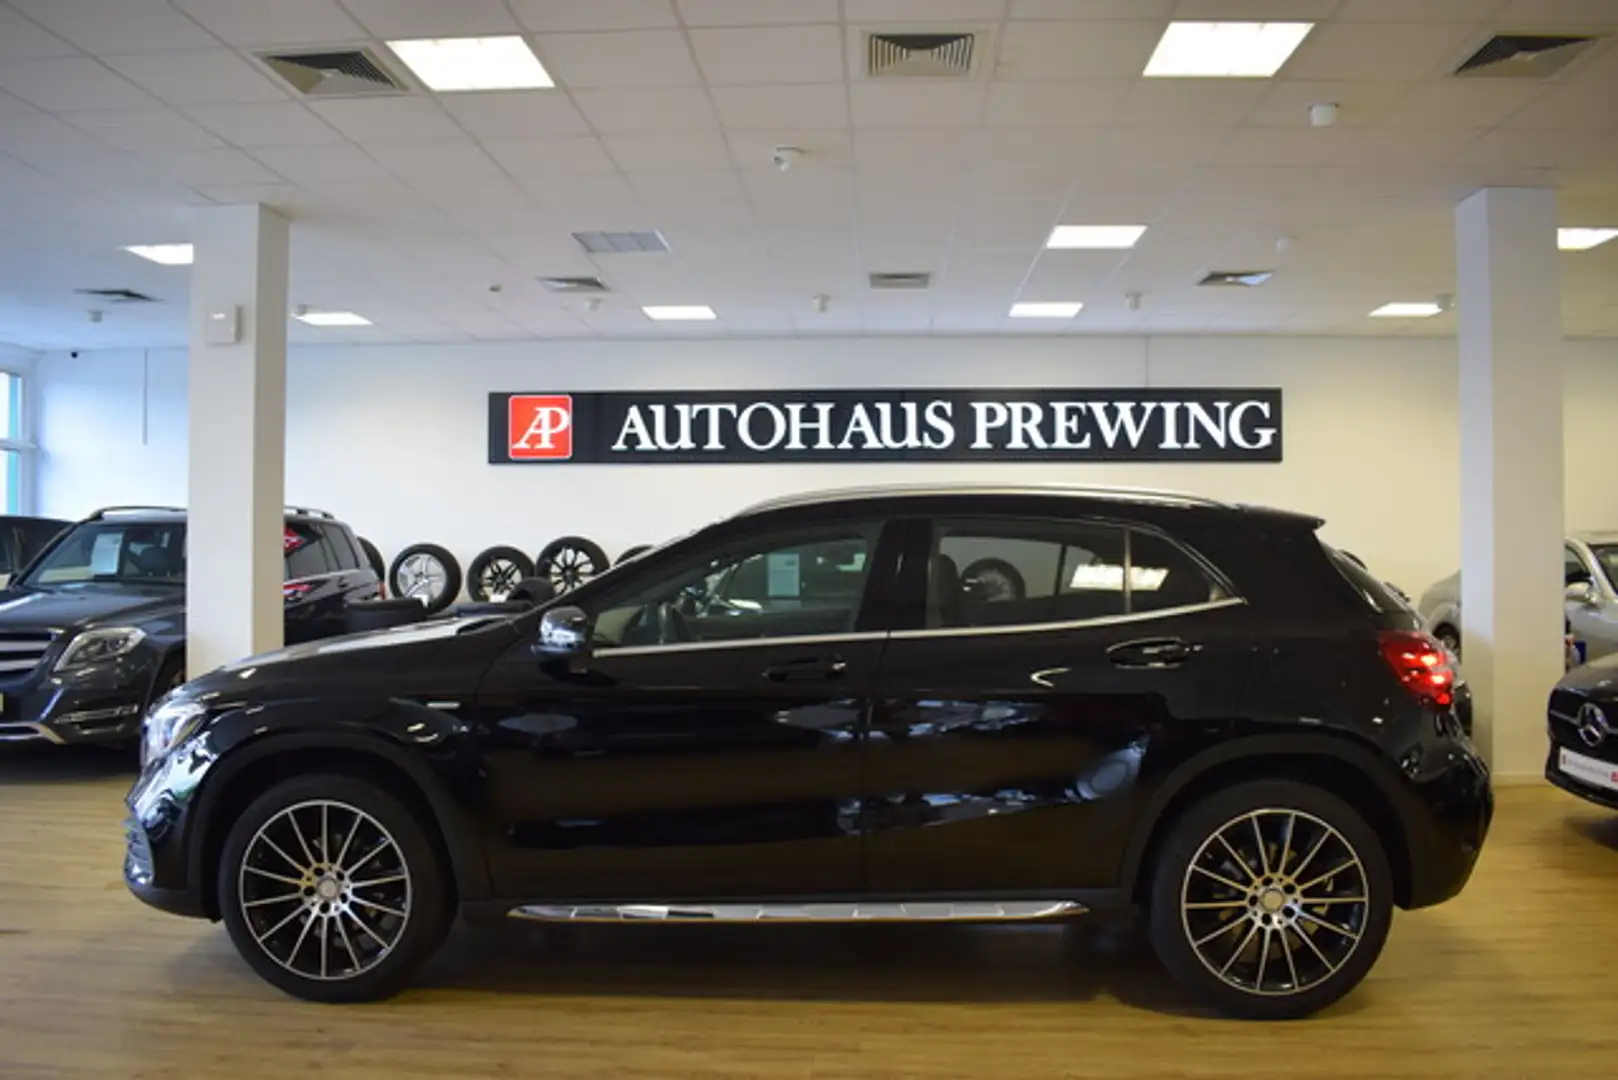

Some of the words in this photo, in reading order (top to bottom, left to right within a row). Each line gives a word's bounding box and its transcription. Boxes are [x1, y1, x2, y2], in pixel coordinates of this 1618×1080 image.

[511, 406, 570, 449] AP
[611, 401, 954, 451] AUTOHAUS
[970, 400, 1277, 450] PREWING
